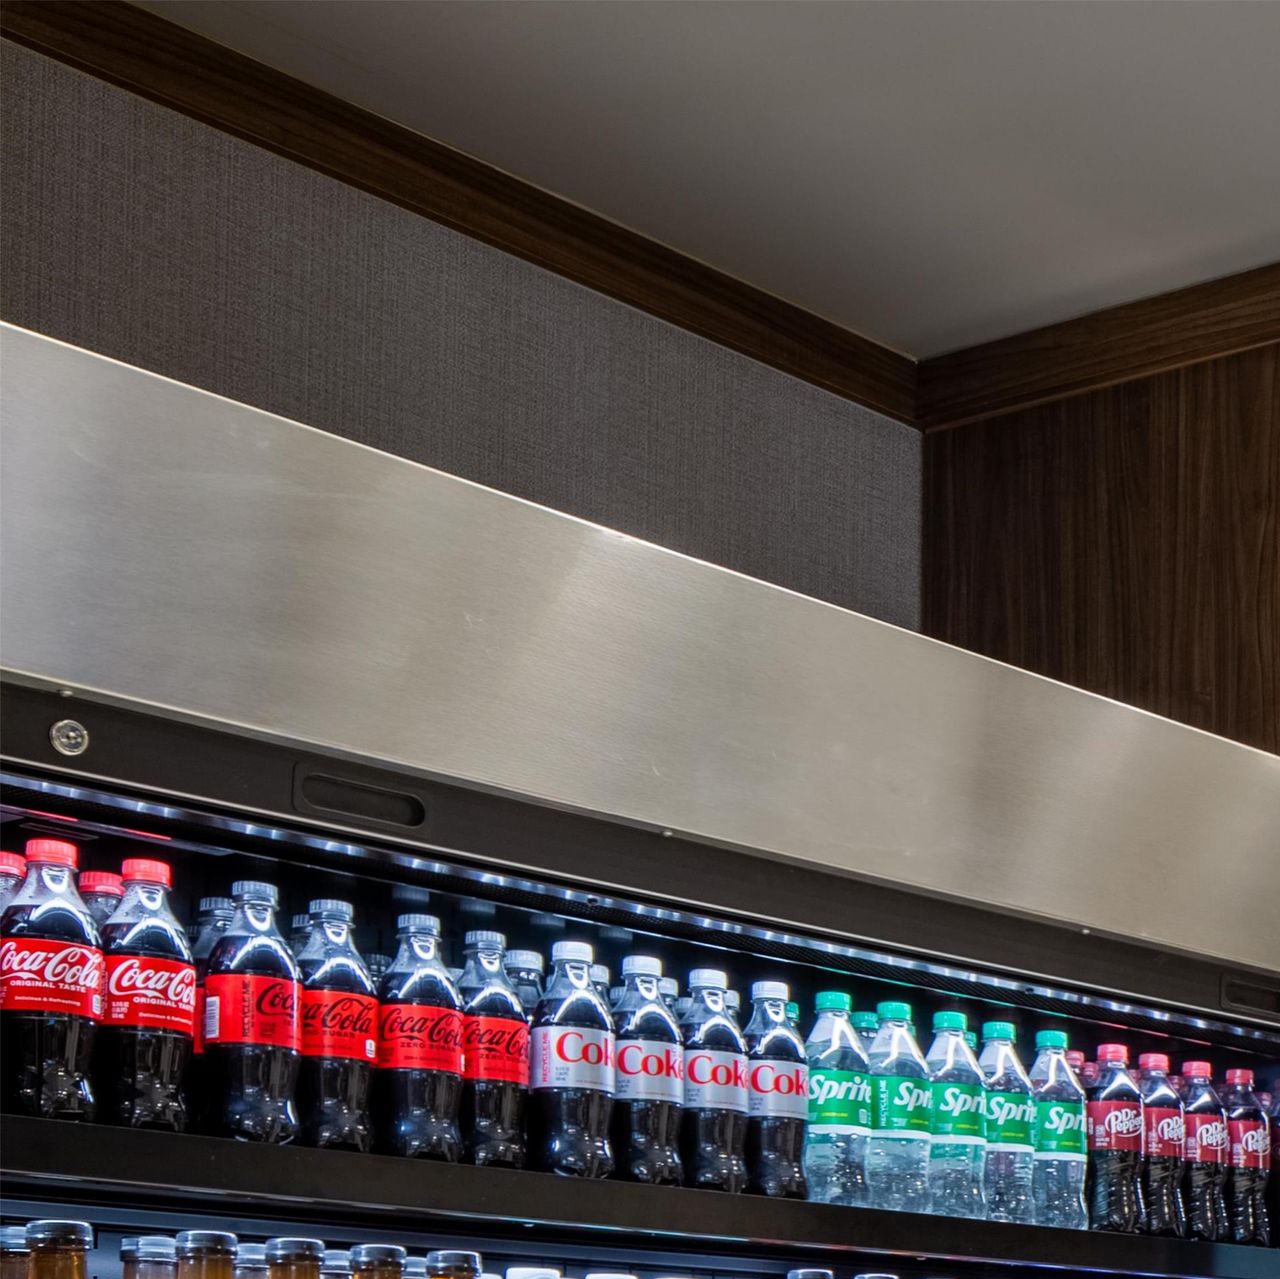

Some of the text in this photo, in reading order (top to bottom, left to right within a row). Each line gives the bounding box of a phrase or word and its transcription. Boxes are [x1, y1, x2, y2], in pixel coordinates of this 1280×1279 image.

[10, 979, 87, 994] ORIGINAL TASTE
[109, 959, 196, 1006] Coca-Co
[133, 996, 175, 1008] ORIGINAL
[400, 1041, 426, 1049] ZERO
[555, 1031, 615, 1069] Cok
[1121, 1108, 1138, 1121] Dr
